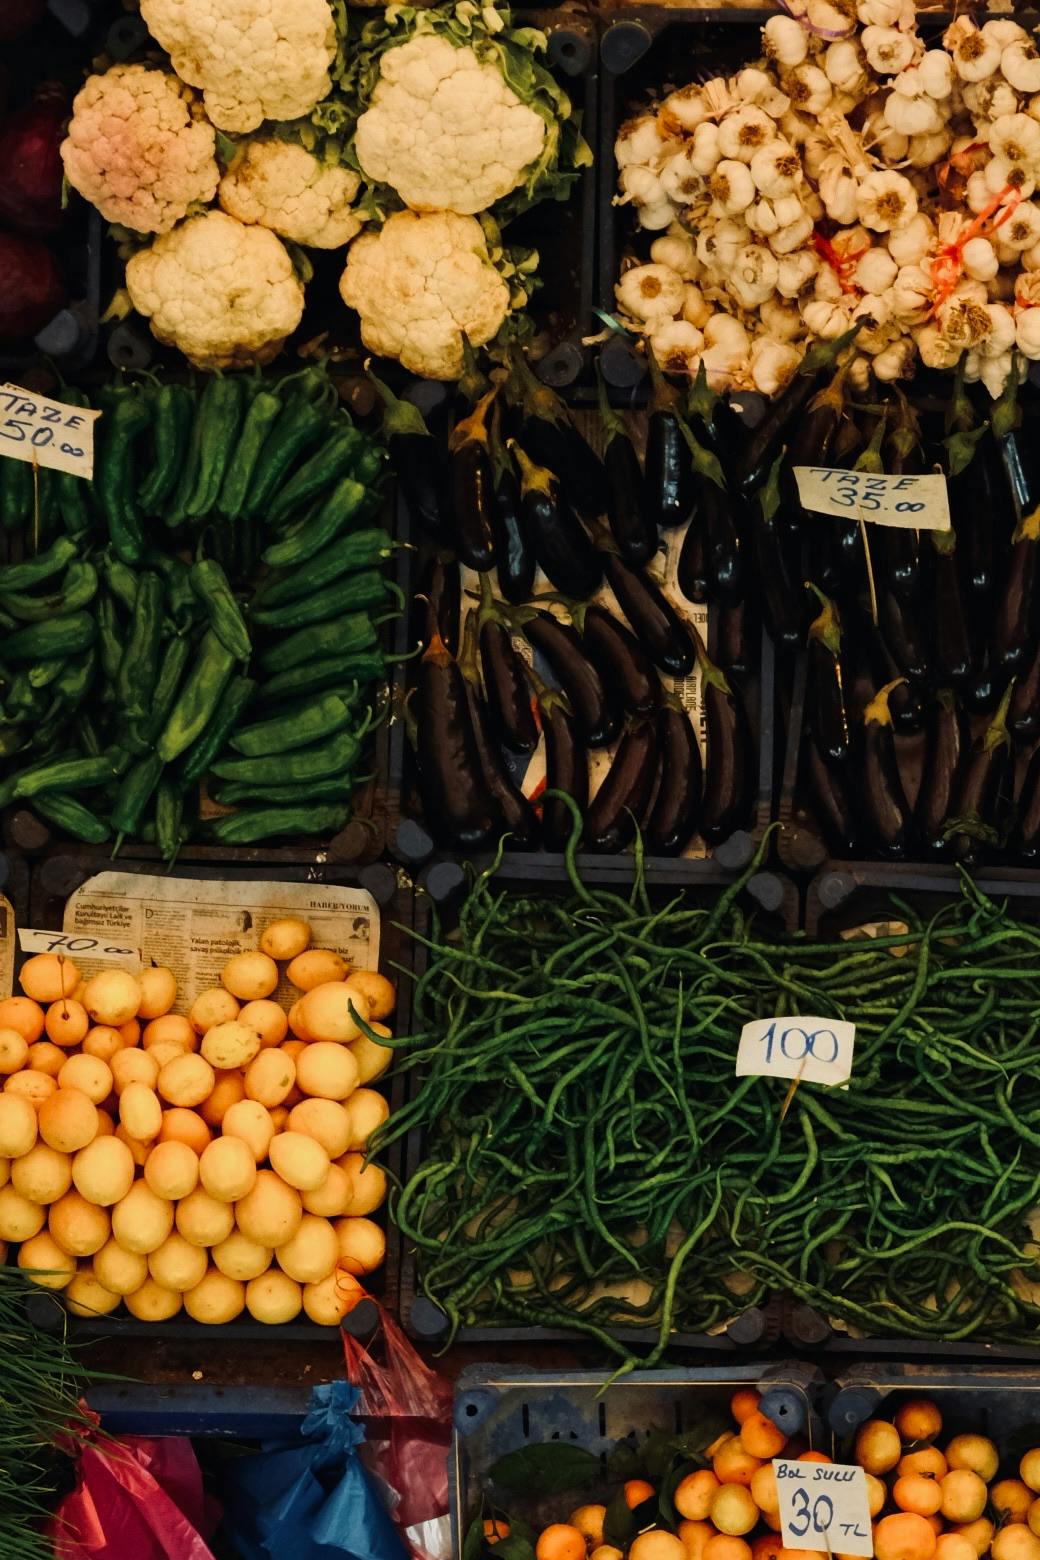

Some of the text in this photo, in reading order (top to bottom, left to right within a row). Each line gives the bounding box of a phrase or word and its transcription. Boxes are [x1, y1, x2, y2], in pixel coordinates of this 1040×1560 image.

[0, 392, 86, 430] TAZE
[810, 468, 919, 491] TAZE
[759, 1022, 839, 1064] 100
[812, 1467, 856, 1482] SULU
[788, 1487, 868, 1537] 30 TL
